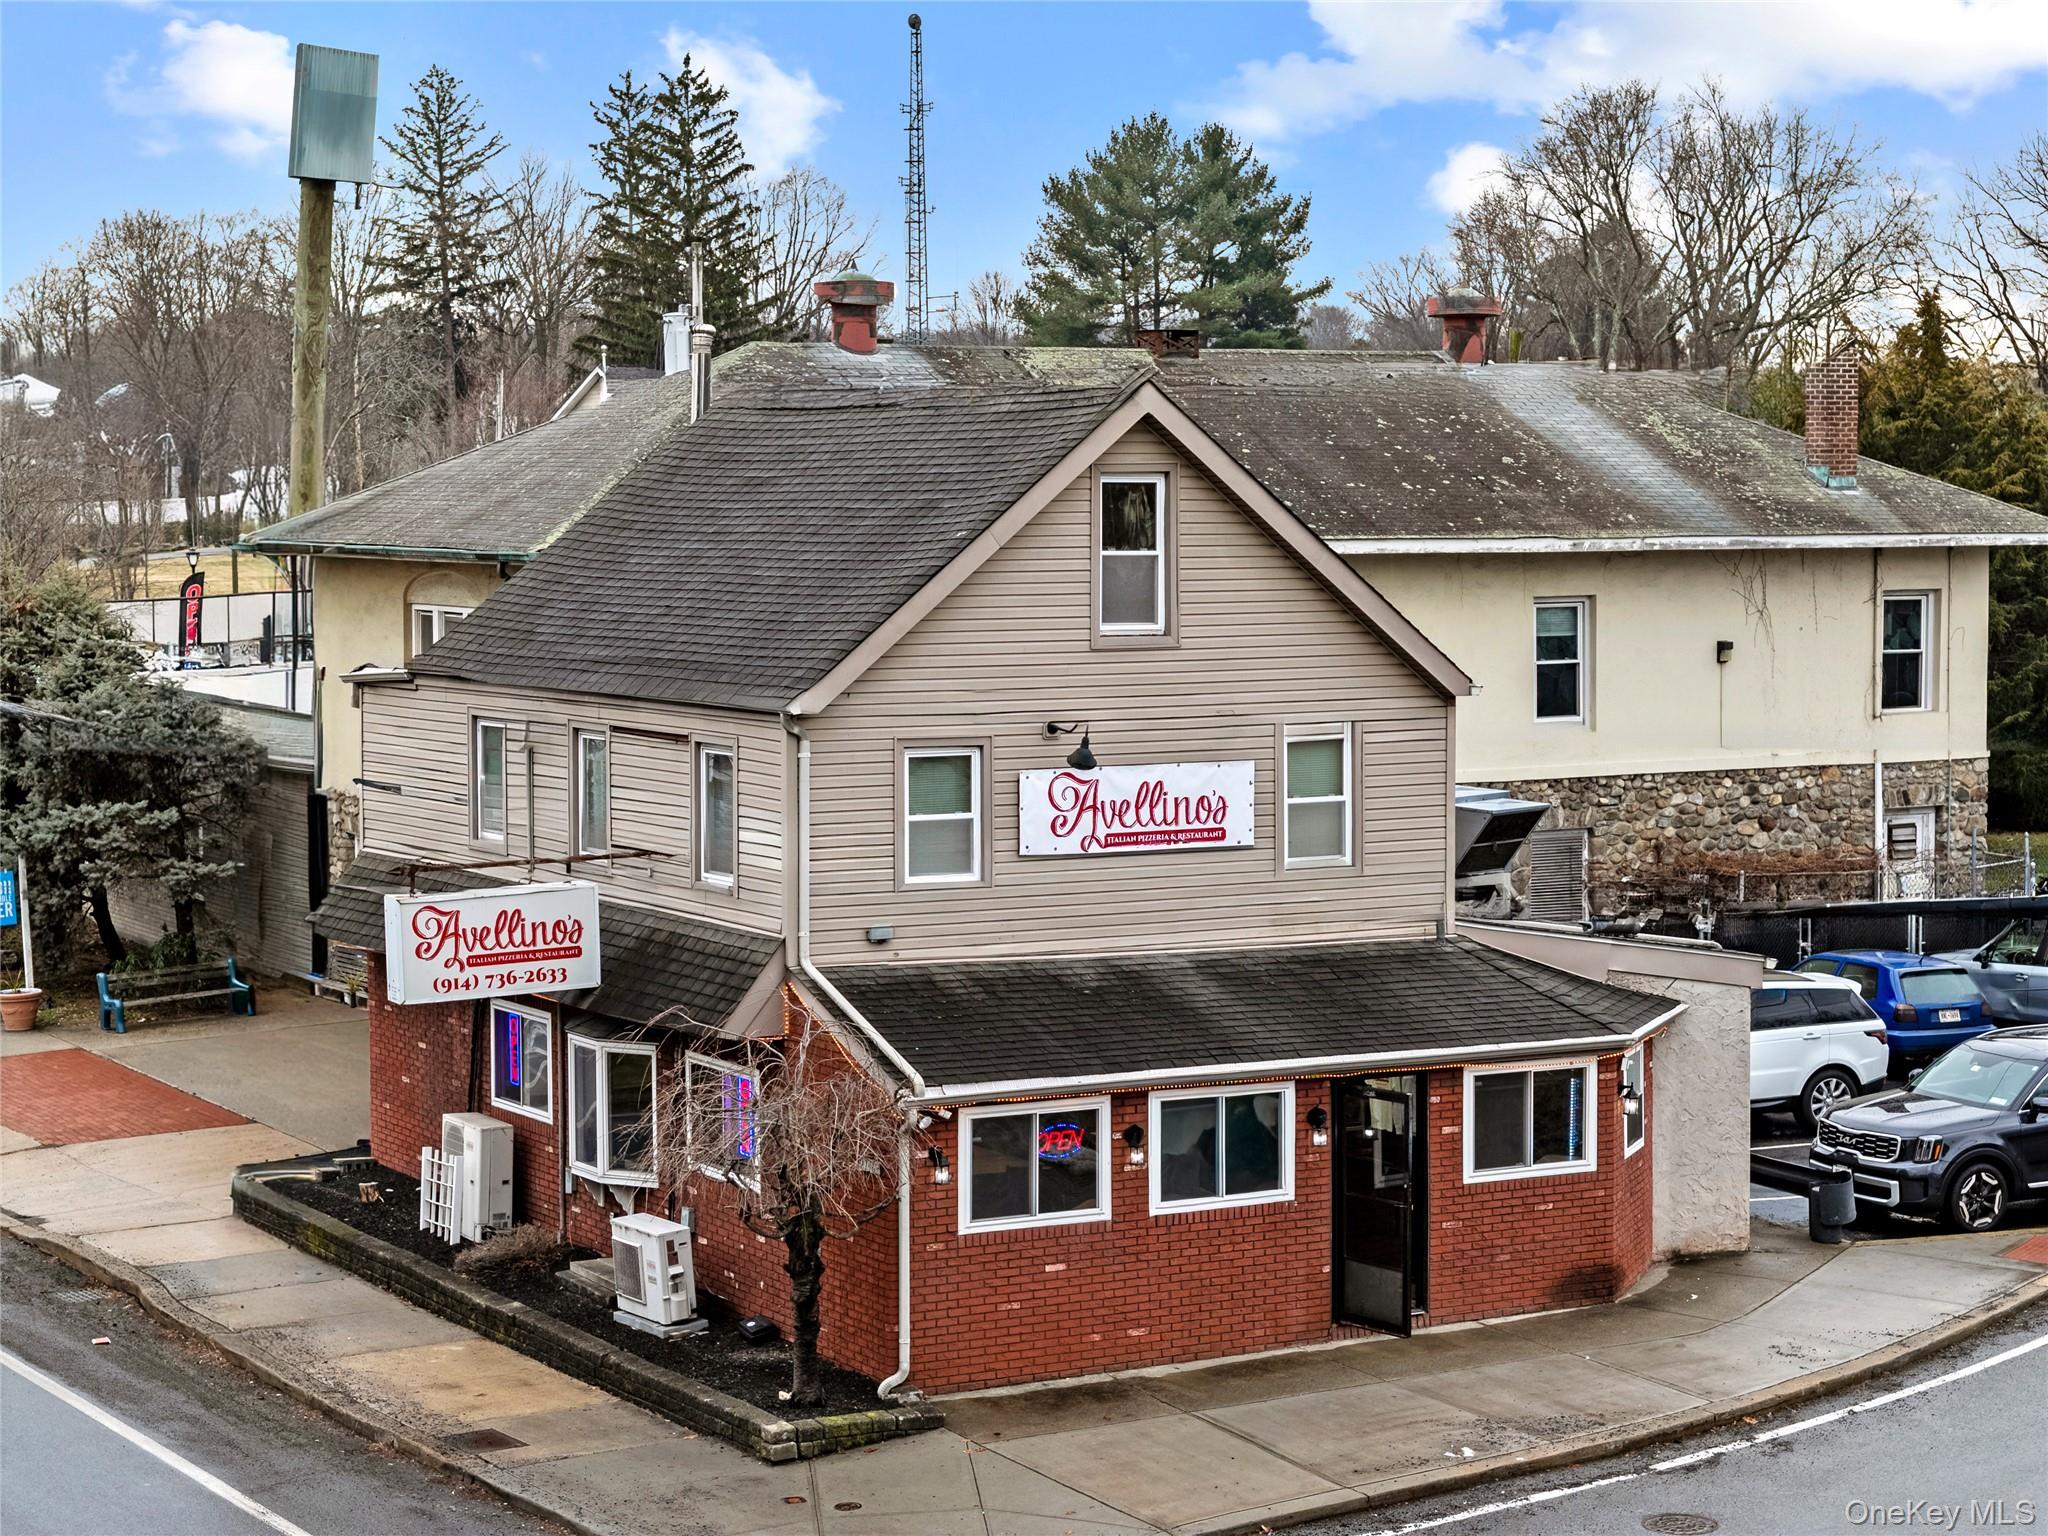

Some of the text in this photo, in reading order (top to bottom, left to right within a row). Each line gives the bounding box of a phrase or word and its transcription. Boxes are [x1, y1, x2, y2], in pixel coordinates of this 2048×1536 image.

[1047, 771, 1229, 852] Avellino's
[1107, 830, 1223, 844] ITALIAN PIZZERIA & RESTAURANT
[411, 905, 584, 973] Avellino's
[469, 948, 579, 965] ITALIAN PIZZERIA & RESTAURANT
[432, 967, 567, 994] (914) 736-2633
[1038, 1128, 1085, 1152] OPEN
